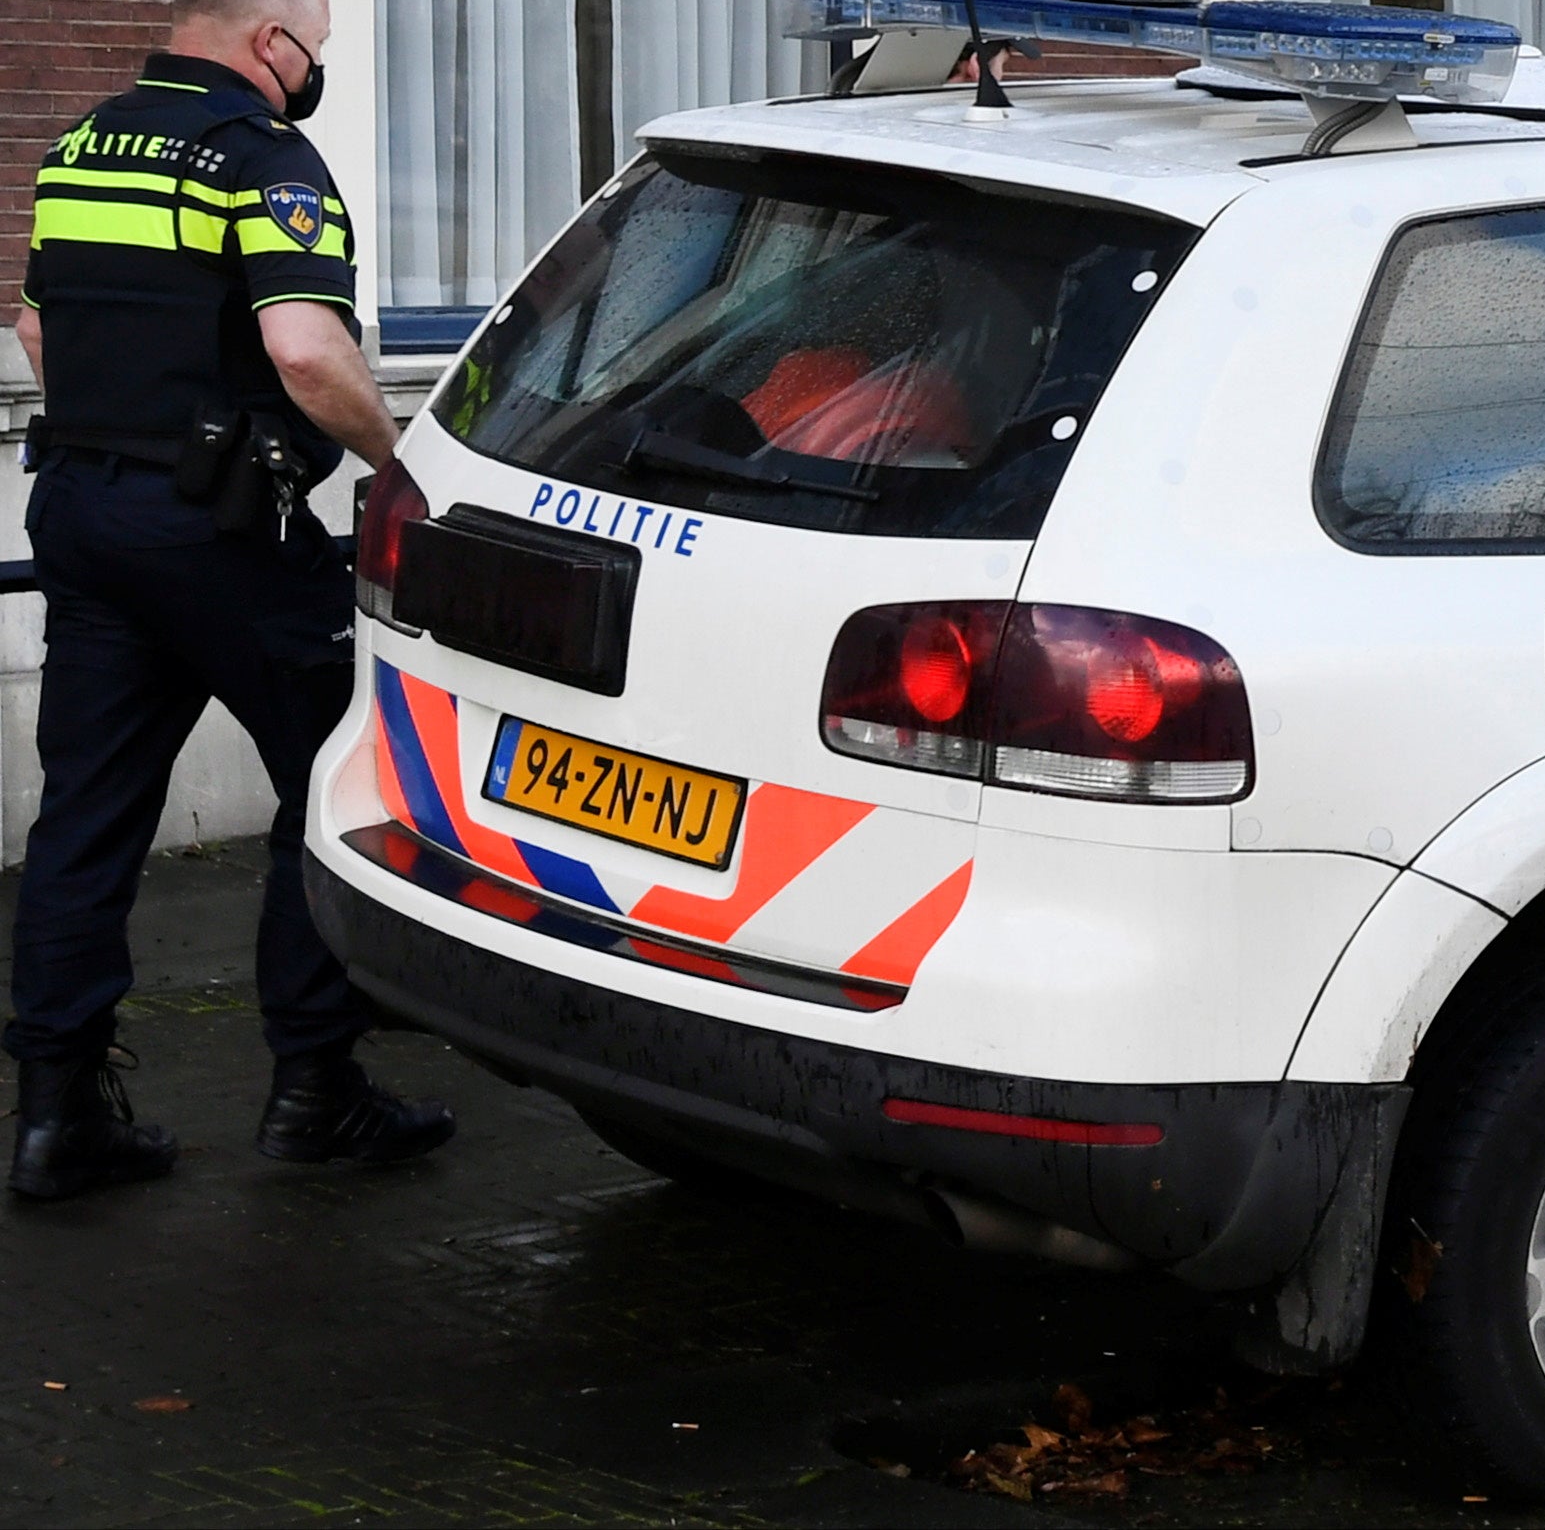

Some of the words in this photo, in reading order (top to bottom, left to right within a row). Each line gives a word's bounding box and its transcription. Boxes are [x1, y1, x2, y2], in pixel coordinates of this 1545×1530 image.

[271, 190, 318, 205] POLITIE
[529, 482, 704, 558] POLITIE
[492, 765, 507, 785] NL
[523, 737, 718, 846] 94-ZN-NJ
